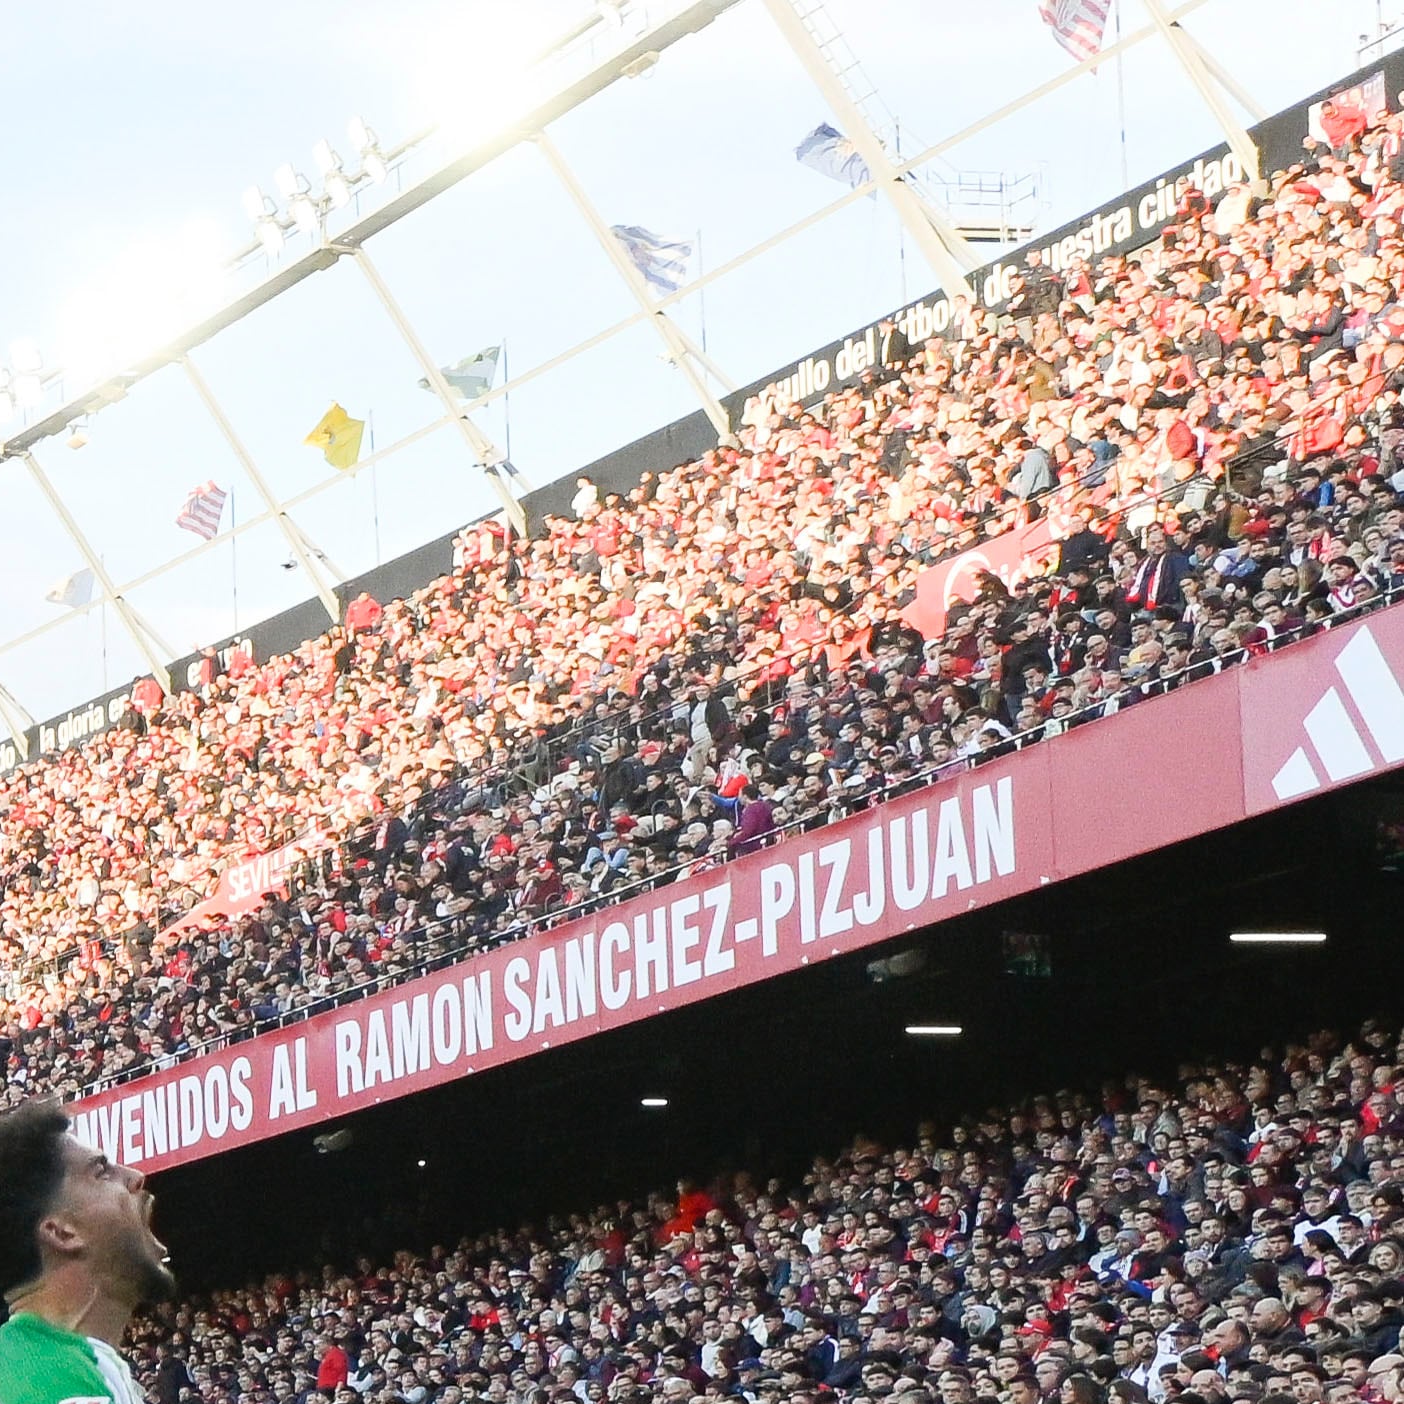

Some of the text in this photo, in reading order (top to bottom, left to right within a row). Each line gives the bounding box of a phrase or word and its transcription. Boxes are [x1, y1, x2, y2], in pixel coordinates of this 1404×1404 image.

[836, 328, 875, 381] del
[1041, 206, 1132, 272] uestra
[39, 725, 55, 753] la
[58, 703, 104, 752] gloria
[72, 776, 1016, 1167] NVENIDOS AL RAMON SANCHEZ-PIZJUAN
